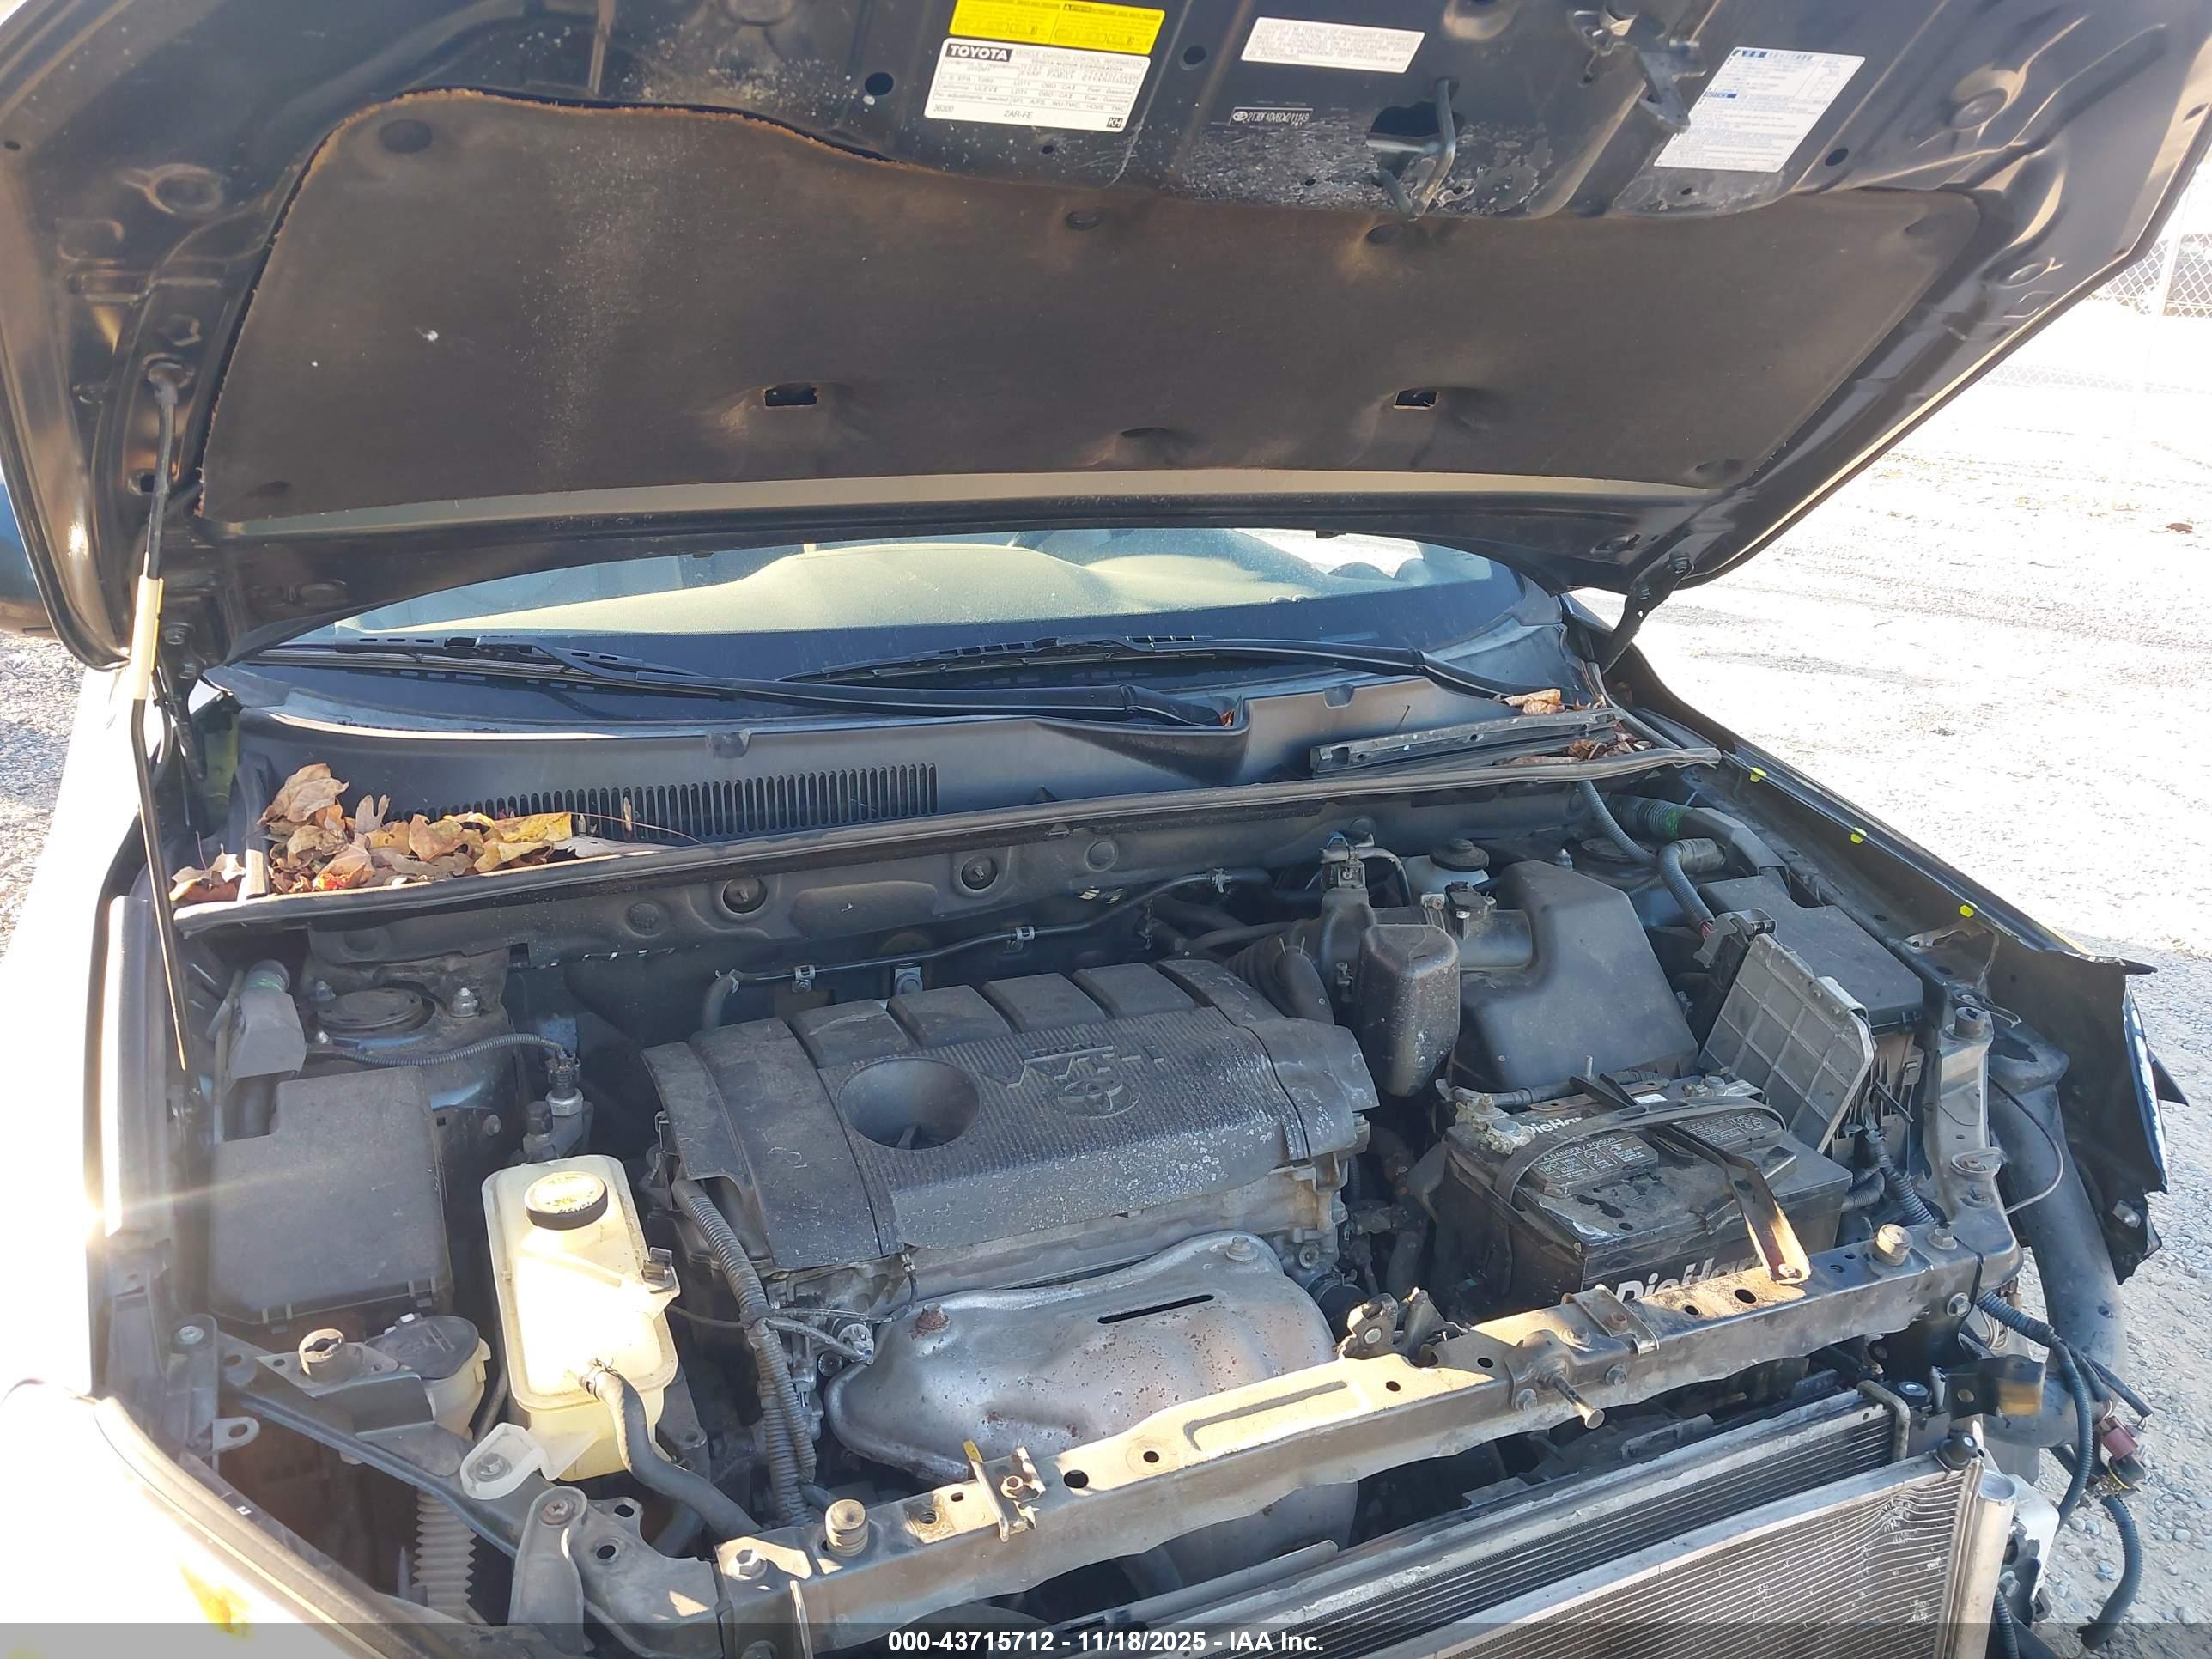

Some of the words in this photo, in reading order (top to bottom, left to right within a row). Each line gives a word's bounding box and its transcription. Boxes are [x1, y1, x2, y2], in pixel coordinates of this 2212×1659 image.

[951, 45, 1007, 60] TOYOTA
[1549, 1146, 1582, 1159] DANGER
[1586, 1136, 1617, 1149] POISON
